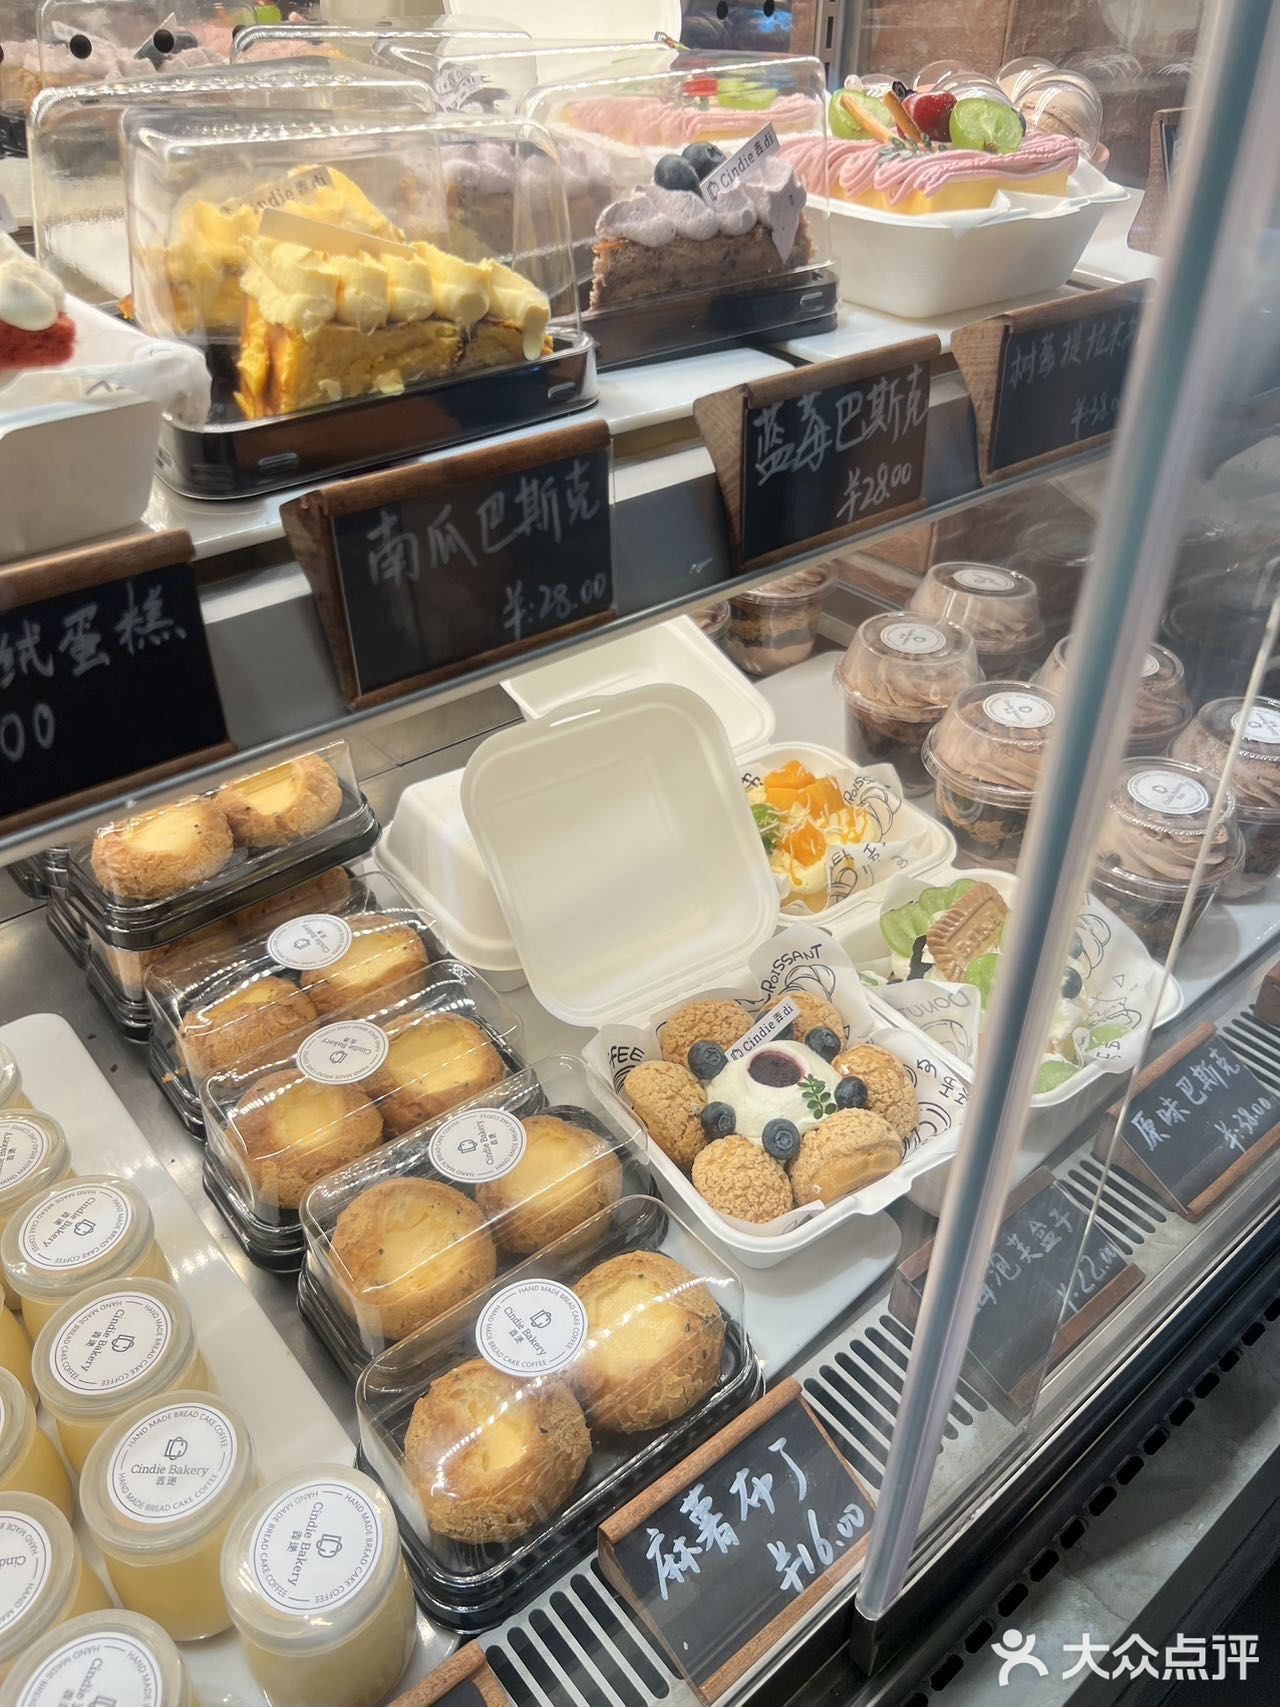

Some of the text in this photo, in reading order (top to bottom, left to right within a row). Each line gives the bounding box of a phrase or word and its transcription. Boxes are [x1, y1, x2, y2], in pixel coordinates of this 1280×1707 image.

[720, 153, 755, 188] Cindie
[753, 363, 930, 487] 蓝莓巴斯克
[366, 459, 600, 587] 南瓜巴斯克
[742, 1019, 776, 1052] Cindie
[1130, 1047, 1241, 1152] 原味巴斯克
[43, 1197, 96, 1248] Cindie Bakery
[518, 1285, 540, 1294] HAND
[540, 1285, 561, 1296] MADE
[143, 1304, 160, 1319] HAND
[503, 1306, 548, 1357] Cindie Bakery
[60, 1300, 123, 1381] HAND MADE BREAD CAKE COFFEE
[80, 1308, 126, 1372] Cindie Bakery
[100, 1373, 130, 1387] COFFEE
[129, 1359, 149, 1376] CAKE
[520, 1359, 547, 1368] COFFEE
[127, 1410, 228, 1449] HAND MADE BREAD CAKE COFFEE
[130, 1463, 210, 1478] Cindie Bakery
[119, 1472, 219, 1513] HAND MADE BREAD CAKE COFFEE
[646, 1436, 808, 1601] 麻薯布丁
[25, 1533, 39, 1555] HAND
[260, 1490, 319, 1598] HAND MADE BREAD CAKE COFFEE
[287, 1500, 324, 1587] Cindie Bakery
[314, 1493, 374, 1604] HAND MADE BREAD CAKE COFFEE
[76, 1657, 104, 1699] Cindie
[127, 1650, 148, 1674] HAND
